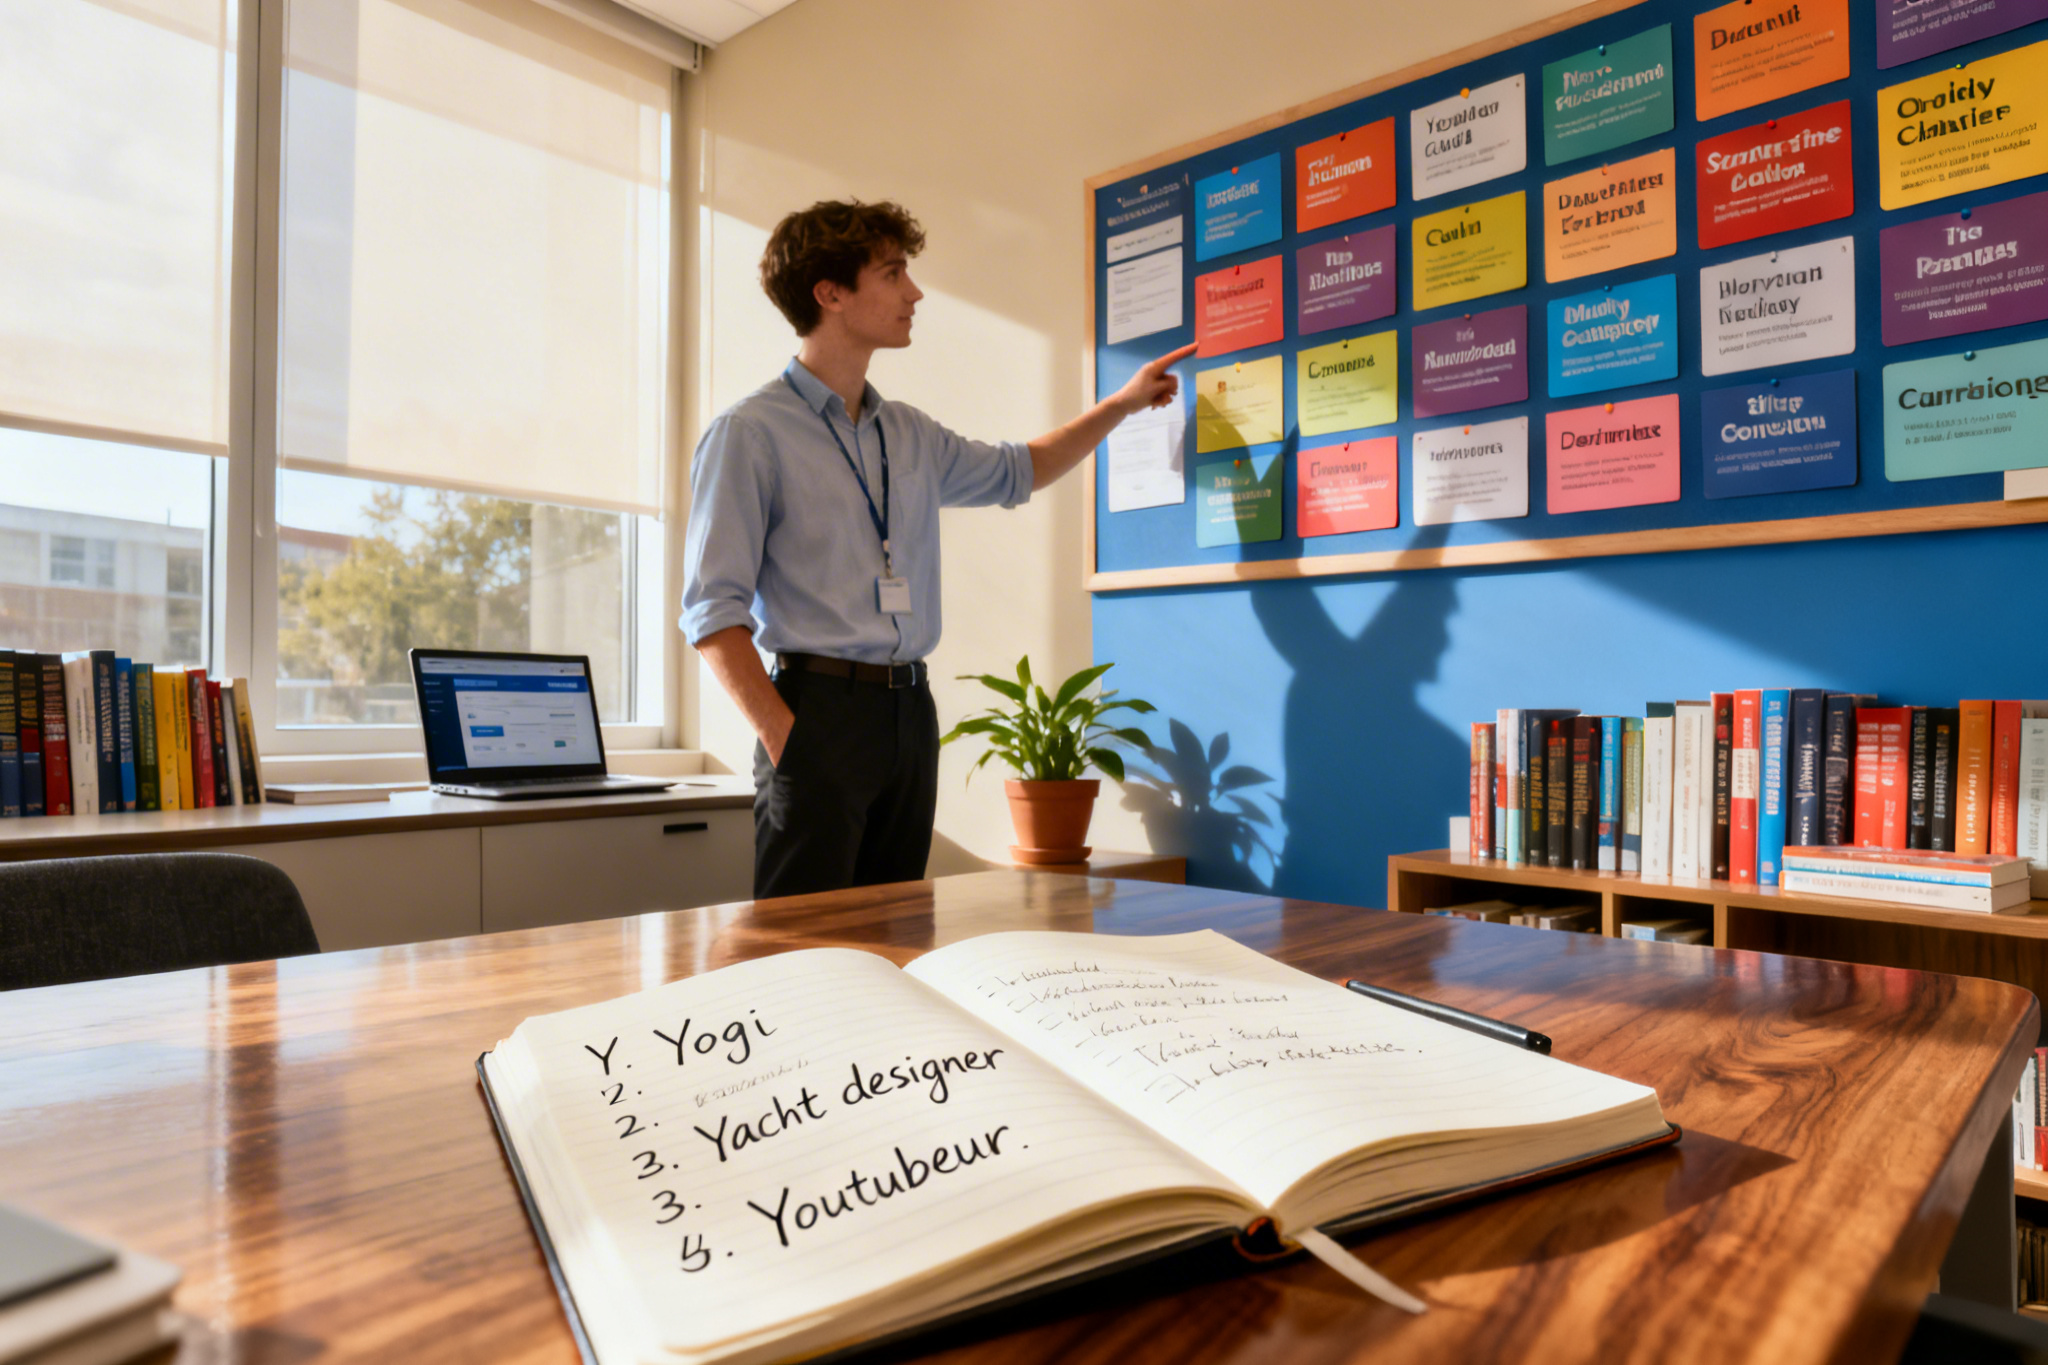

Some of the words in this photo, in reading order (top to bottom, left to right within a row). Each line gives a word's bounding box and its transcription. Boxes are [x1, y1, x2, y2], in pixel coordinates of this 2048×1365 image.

[653, 1009, 777, 1065] Yogi
[601, 1083, 642, 1106] 2.
[615, 1115, 659, 1139] 2.
[632, 1151, 679, 1180] 3.
[694, 1087, 828, 1163] Yacht
[842, 1048, 1004, 1104] designer
[652, 1190, 702, 1225] 3.
